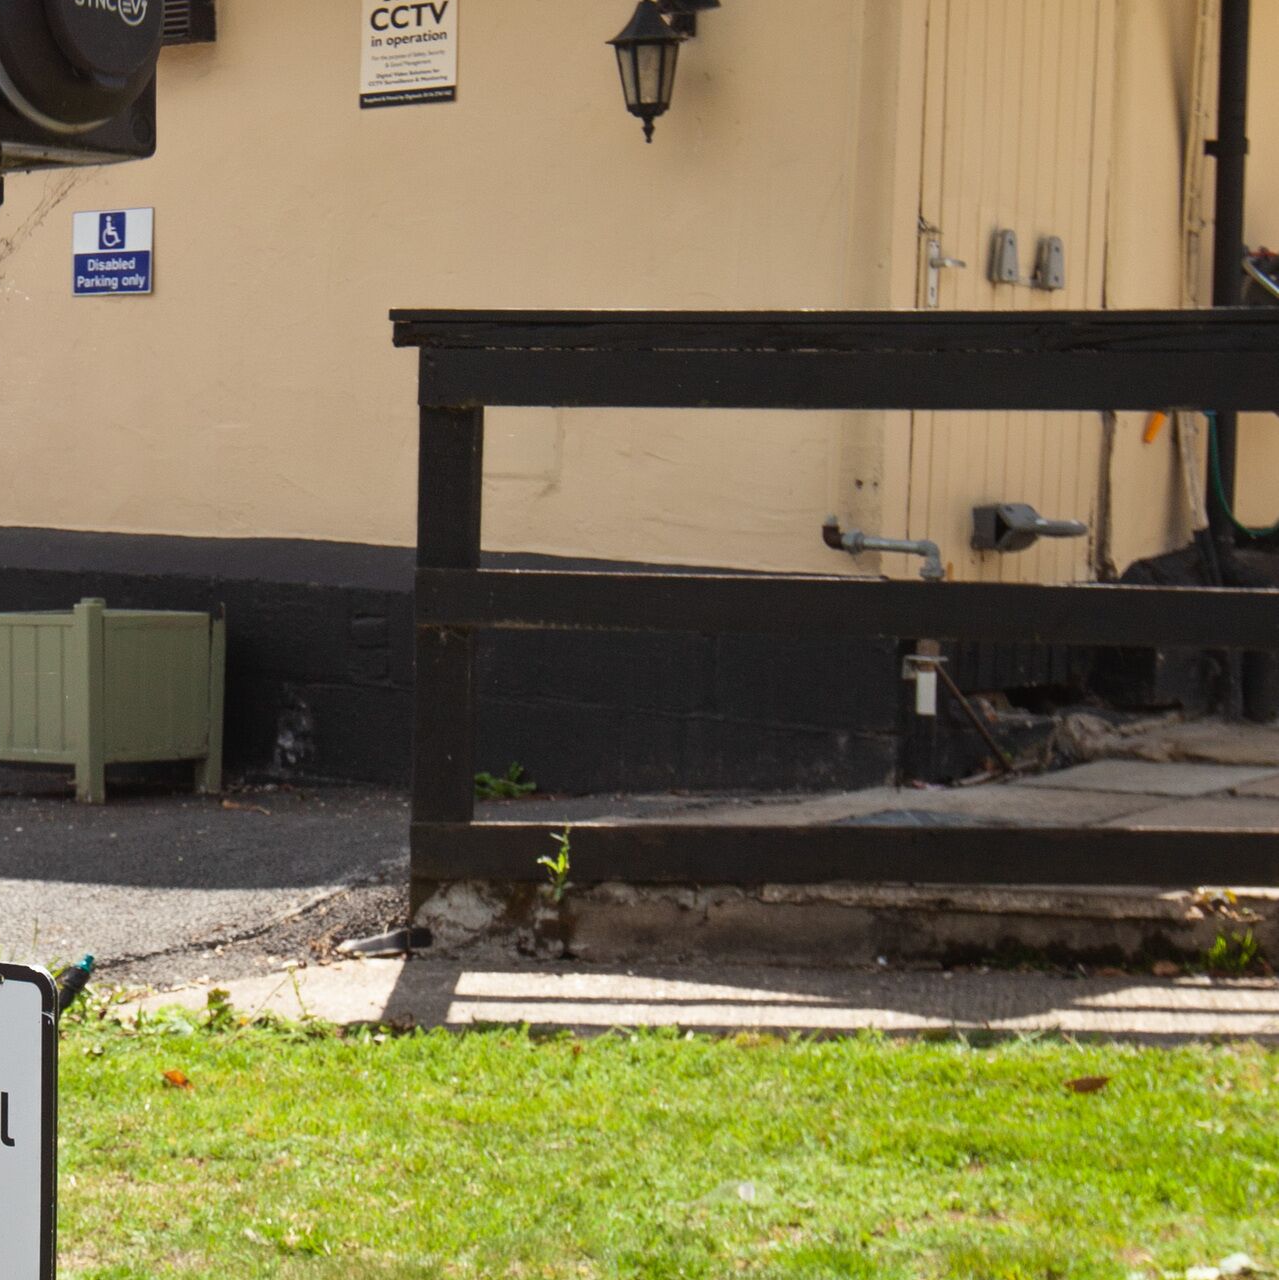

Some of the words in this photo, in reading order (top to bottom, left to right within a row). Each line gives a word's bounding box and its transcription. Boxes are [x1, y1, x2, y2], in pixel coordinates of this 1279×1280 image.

[370, 0, 449, 31] CCTV
[371, 36, 382, 47] in
[386, 30, 448, 48] operation
[87, 257, 136, 271] Disabled
[77, 275, 118, 290] Parking
[121, 273, 146, 289] only
